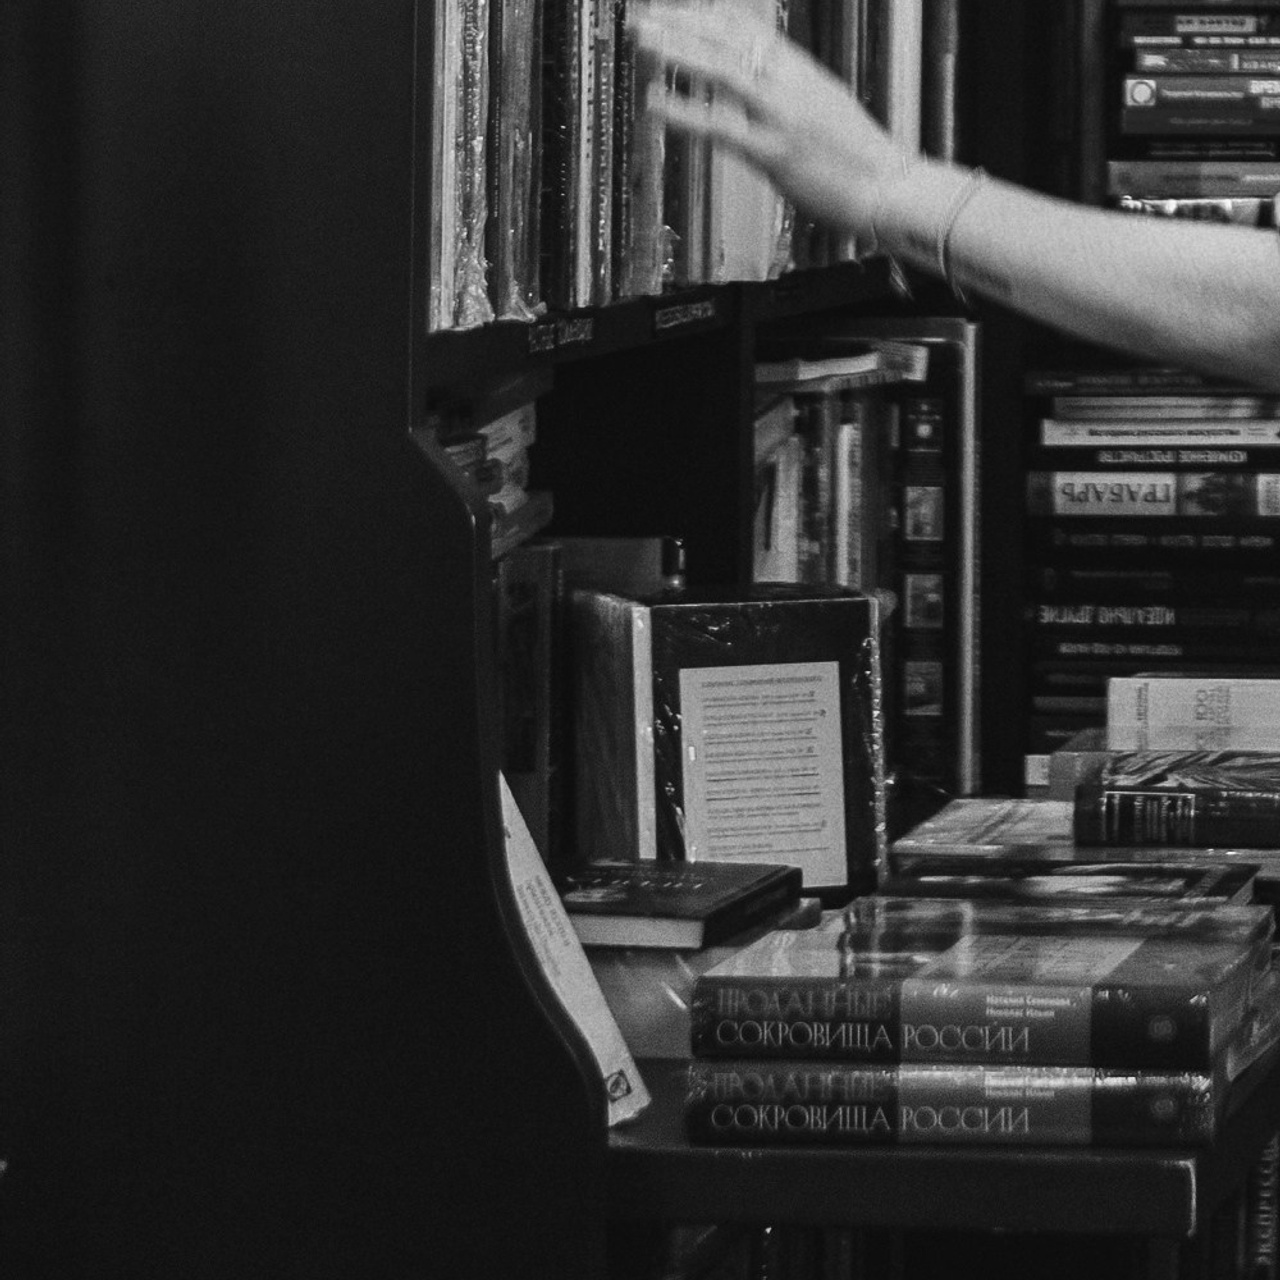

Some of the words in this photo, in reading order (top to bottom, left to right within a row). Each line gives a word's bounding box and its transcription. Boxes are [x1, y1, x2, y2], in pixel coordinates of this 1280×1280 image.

[1060, 482, 1172, 505] ГРАБАРЬ
[715, 1019, 894, 1053] СОКРОВИЩА
[903, 1022, 1030, 1054] РОССИИ
[710, 1103, 893, 1135] СОКРОВИЩА
[899, 1105, 1030, 1135] РОССИИ
